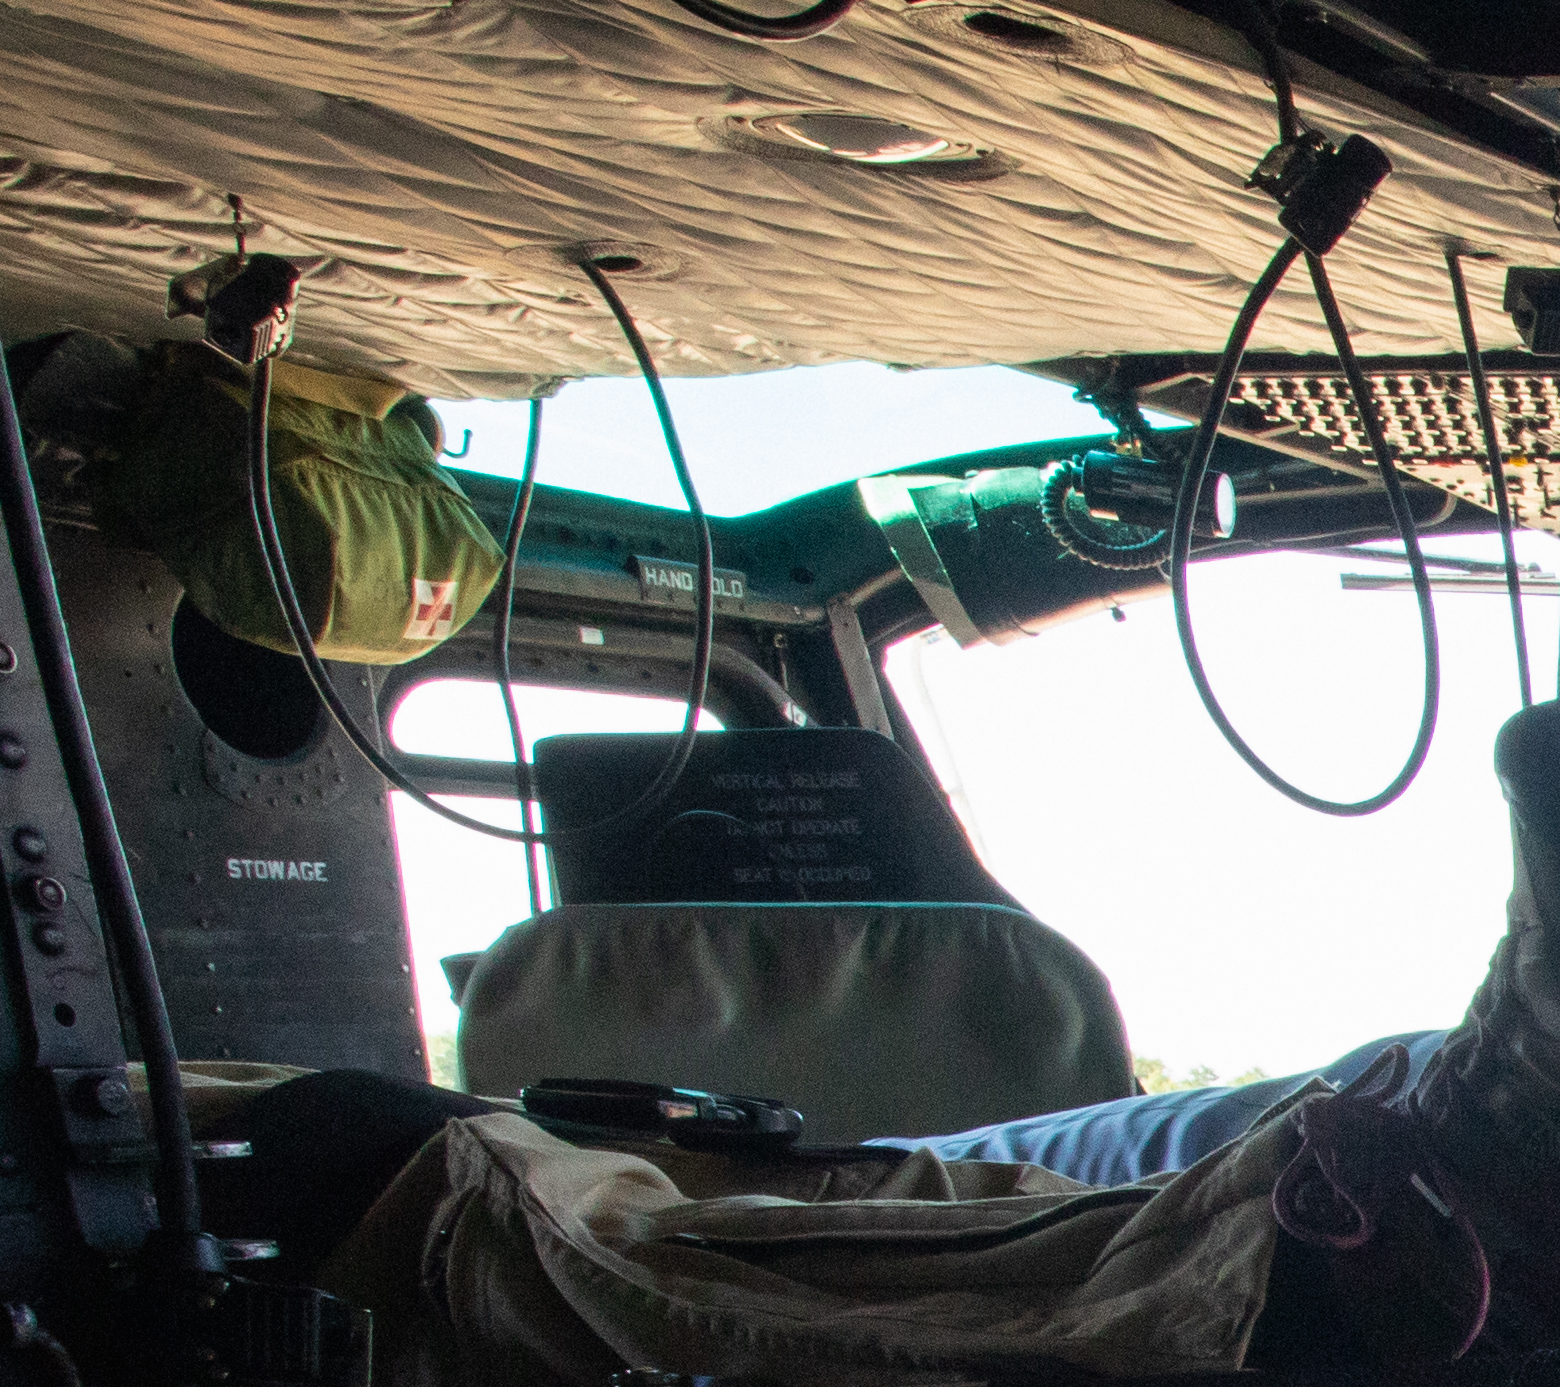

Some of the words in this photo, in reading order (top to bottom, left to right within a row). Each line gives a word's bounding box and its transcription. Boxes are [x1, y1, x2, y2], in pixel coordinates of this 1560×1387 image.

[644, 566, 693, 592] HAND
[711, 576, 744, 598] OLD
[789, 771, 860, 788] RELEASE
[756, 796, 823, 812] CAUTION
[227, 858, 329, 882] STOWAGE
